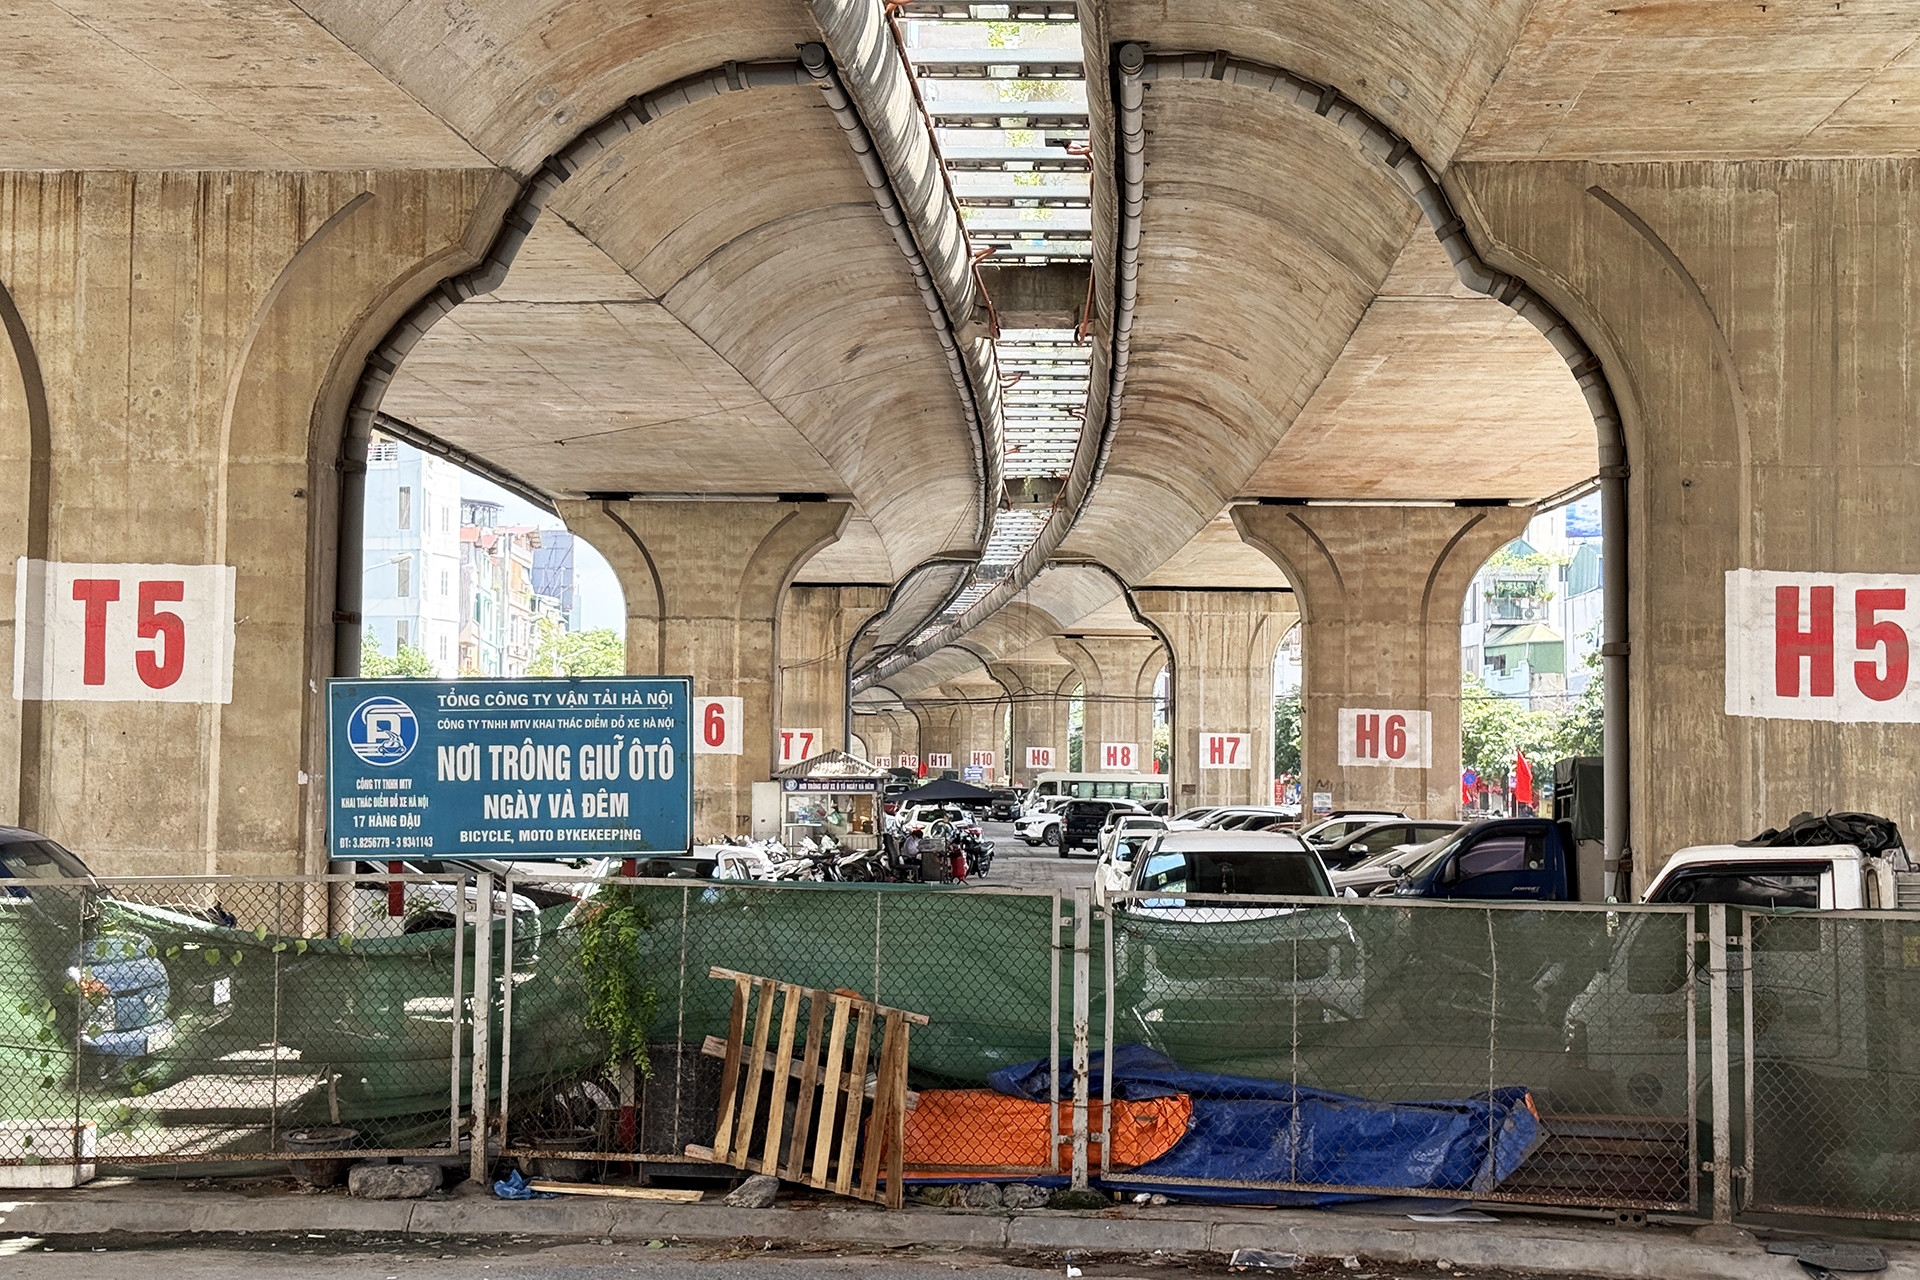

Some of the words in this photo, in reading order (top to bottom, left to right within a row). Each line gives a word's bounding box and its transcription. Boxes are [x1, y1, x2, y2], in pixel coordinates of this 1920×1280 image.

[72, 578, 186, 690] T5
[1775, 585, 1910, 702] H5
[437, 687, 480, 707] TỔNG
[484, 690, 528, 706] CÔNG
[532, 693, 552, 706] TY
[556, 690, 588, 708] VẬN
[592, 688, 617, 705] TẢI
[621, 689, 643, 705] HÀ
[647, 689, 673, 708] NỘI
[437, 717, 465, 730] CÔNG
[467, 719, 480, 729] TY
[481, 719, 508, 729] TNHH
[510, 719, 531, 729] MTV
[532, 719, 556, 729] KHAI
[557, 716, 582, 729] THÁC
[627, 718, 640, 729] XE
[643, 716, 657, 728] HÀ
[657, 716, 674, 730] NỘI
[1356, 714, 1406, 759] H6
[781, 732, 814, 760] T7
[1209, 737, 1241, 764] H7
[437, 742, 481, 782] NƠI
[488, 737, 571, 781] TRÔNG
[579, 734, 625, 781] GIỮ
[628, 737, 674, 781] ÔTÔ
[876, 757, 891, 767] H13
[901, 756, 917, 767] H12
[931, 755, 947, 766] H11
[973, 752, 992, 766] H10
[1032, 749, 1049, 766] H9
[1106, 746, 1131, 766] H8
[374, 779, 381, 790] TY
[382, 779, 398, 790] TNHH
[399, 779, 412, 790] MTV
[341, 797, 356, 809] KHAI
[357, 795, 373, 808] THÁC
[399, 796, 408, 808] XE
[483, 789, 542, 820] NGÀY
[548, 788, 576, 819] VÀ
[582, 787, 629, 818] ĐÊM
[353, 815, 366, 827] 17
[368, 812, 397, 828] HÀNG
[399, 812, 421, 829] ĐẬU
[396, 837, 401, 848] 3
[460, 829, 514, 844] BICYCLE,
[518, 829, 554, 842] MOTO
[556, 828, 642, 841] BYKEKEEPING
